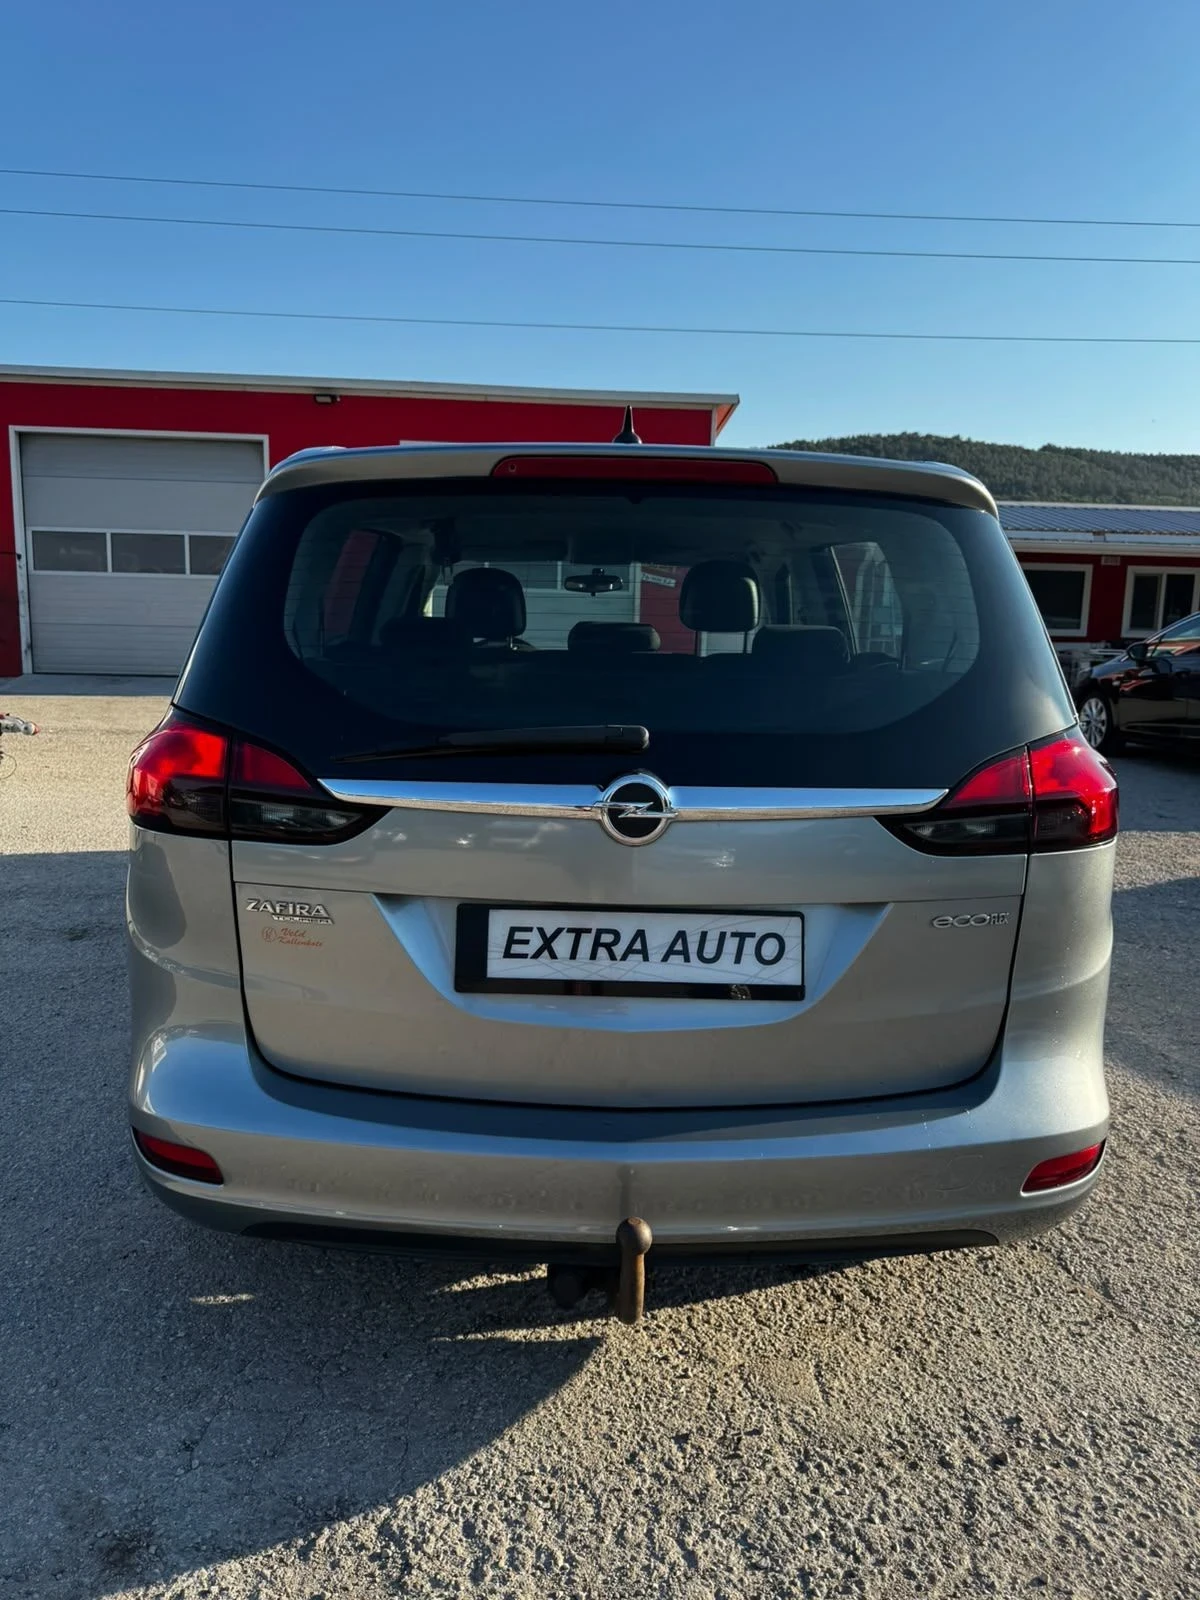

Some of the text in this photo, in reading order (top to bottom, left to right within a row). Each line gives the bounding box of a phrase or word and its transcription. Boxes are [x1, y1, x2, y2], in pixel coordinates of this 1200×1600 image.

[245, 898, 330, 917] ZAFIRA
[502, 926, 786, 966] EXTRA AUTO
